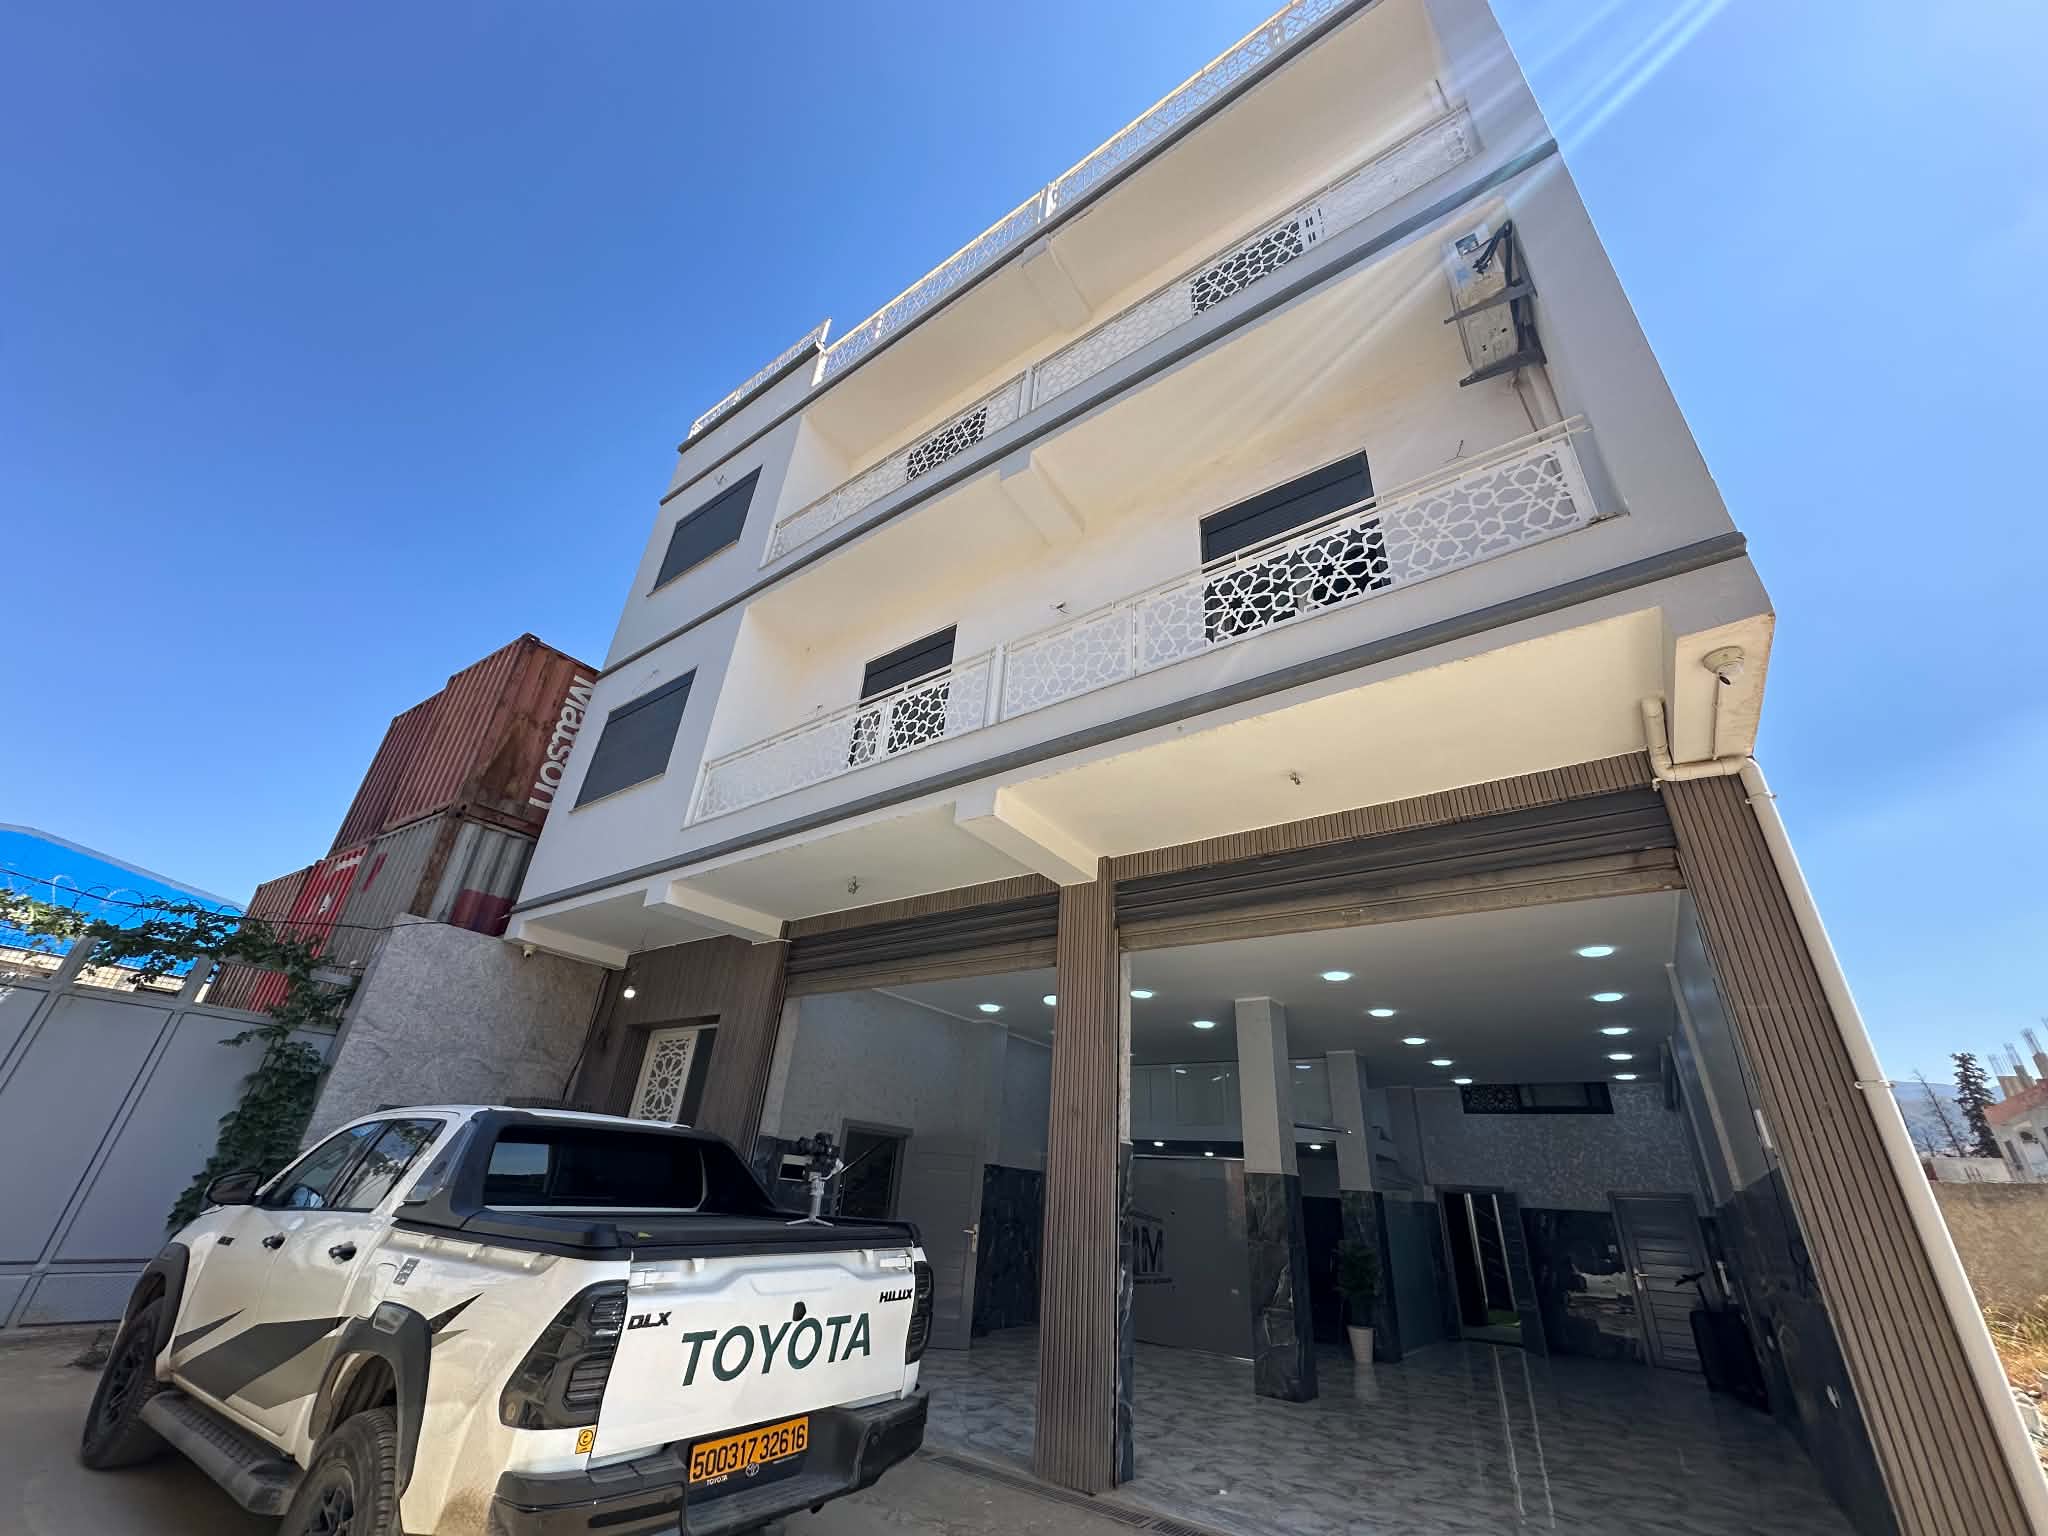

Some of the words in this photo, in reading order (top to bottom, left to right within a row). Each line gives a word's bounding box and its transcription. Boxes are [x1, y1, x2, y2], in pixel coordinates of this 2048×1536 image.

[879, 1288, 913, 1303] HILUX
[627, 1311, 672, 1330] DLX
[681, 1312, 871, 1387] TOYOTA
[706, 1474, 728, 1486] TOYOTA
